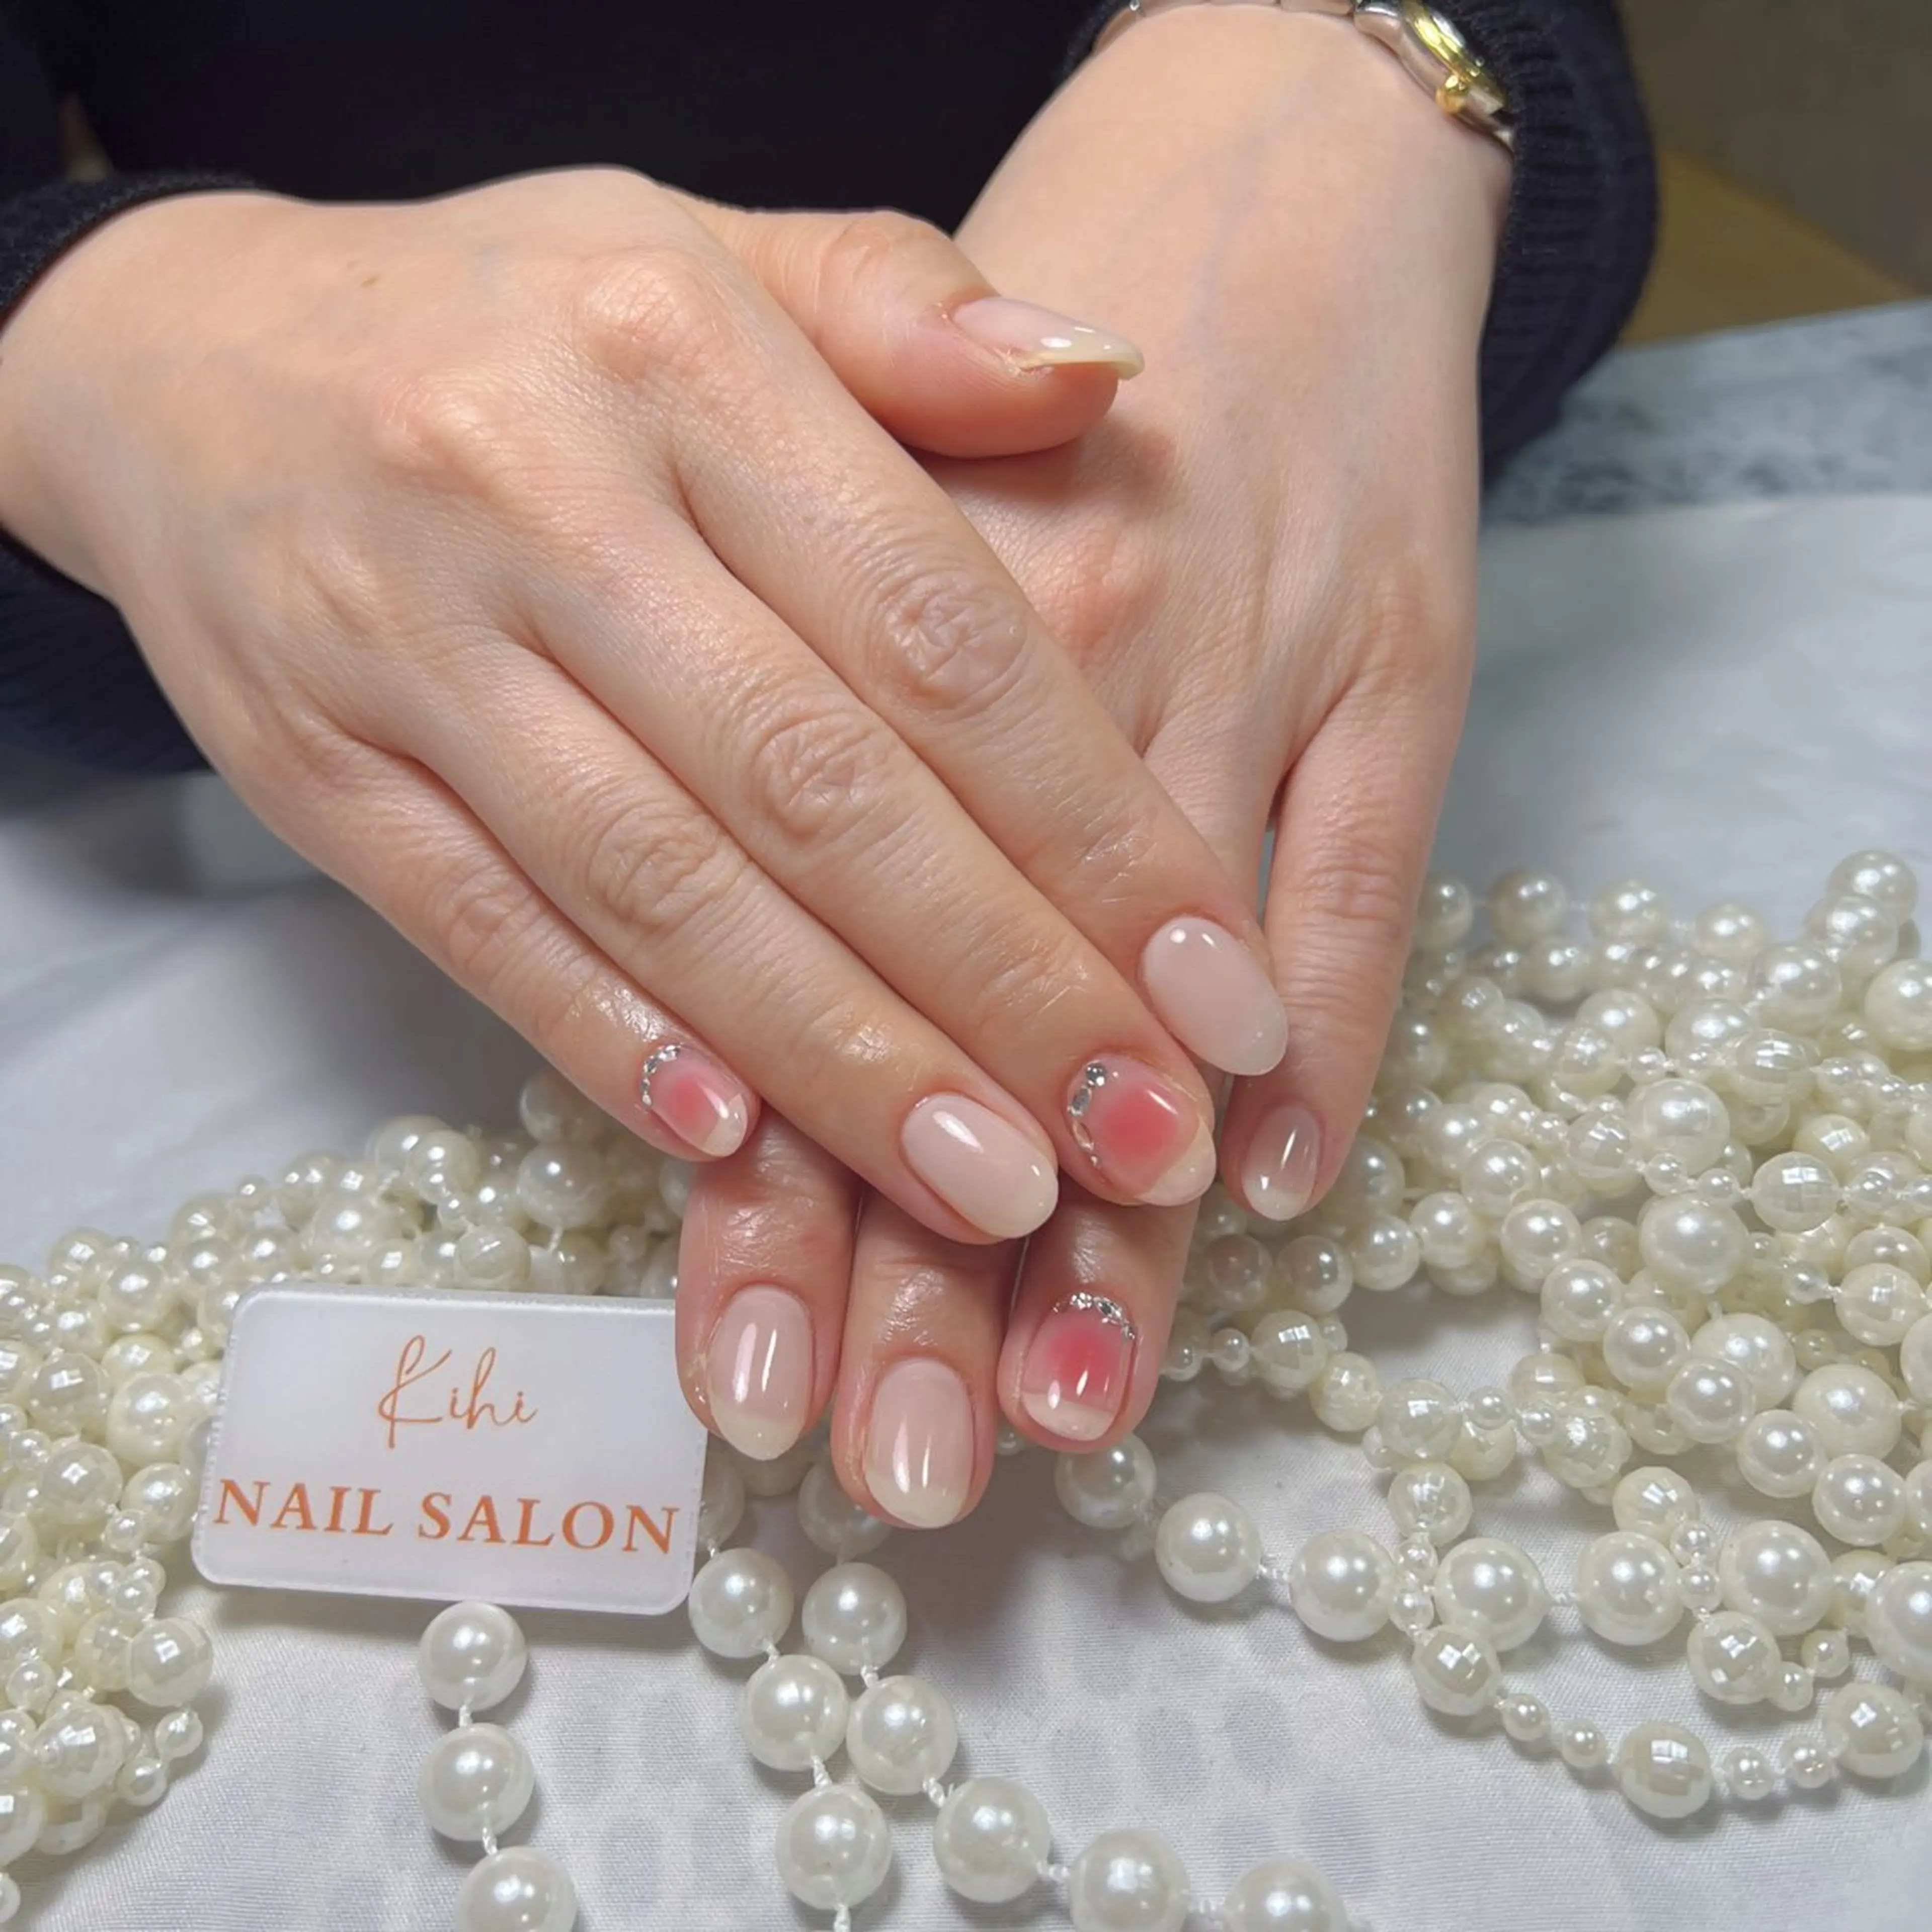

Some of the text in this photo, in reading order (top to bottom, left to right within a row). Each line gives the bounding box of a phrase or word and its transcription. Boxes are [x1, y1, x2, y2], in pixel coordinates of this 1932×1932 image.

[377, 1334, 538, 1449] Kihi
[213, 1478, 680, 1554] NAIL SALON
